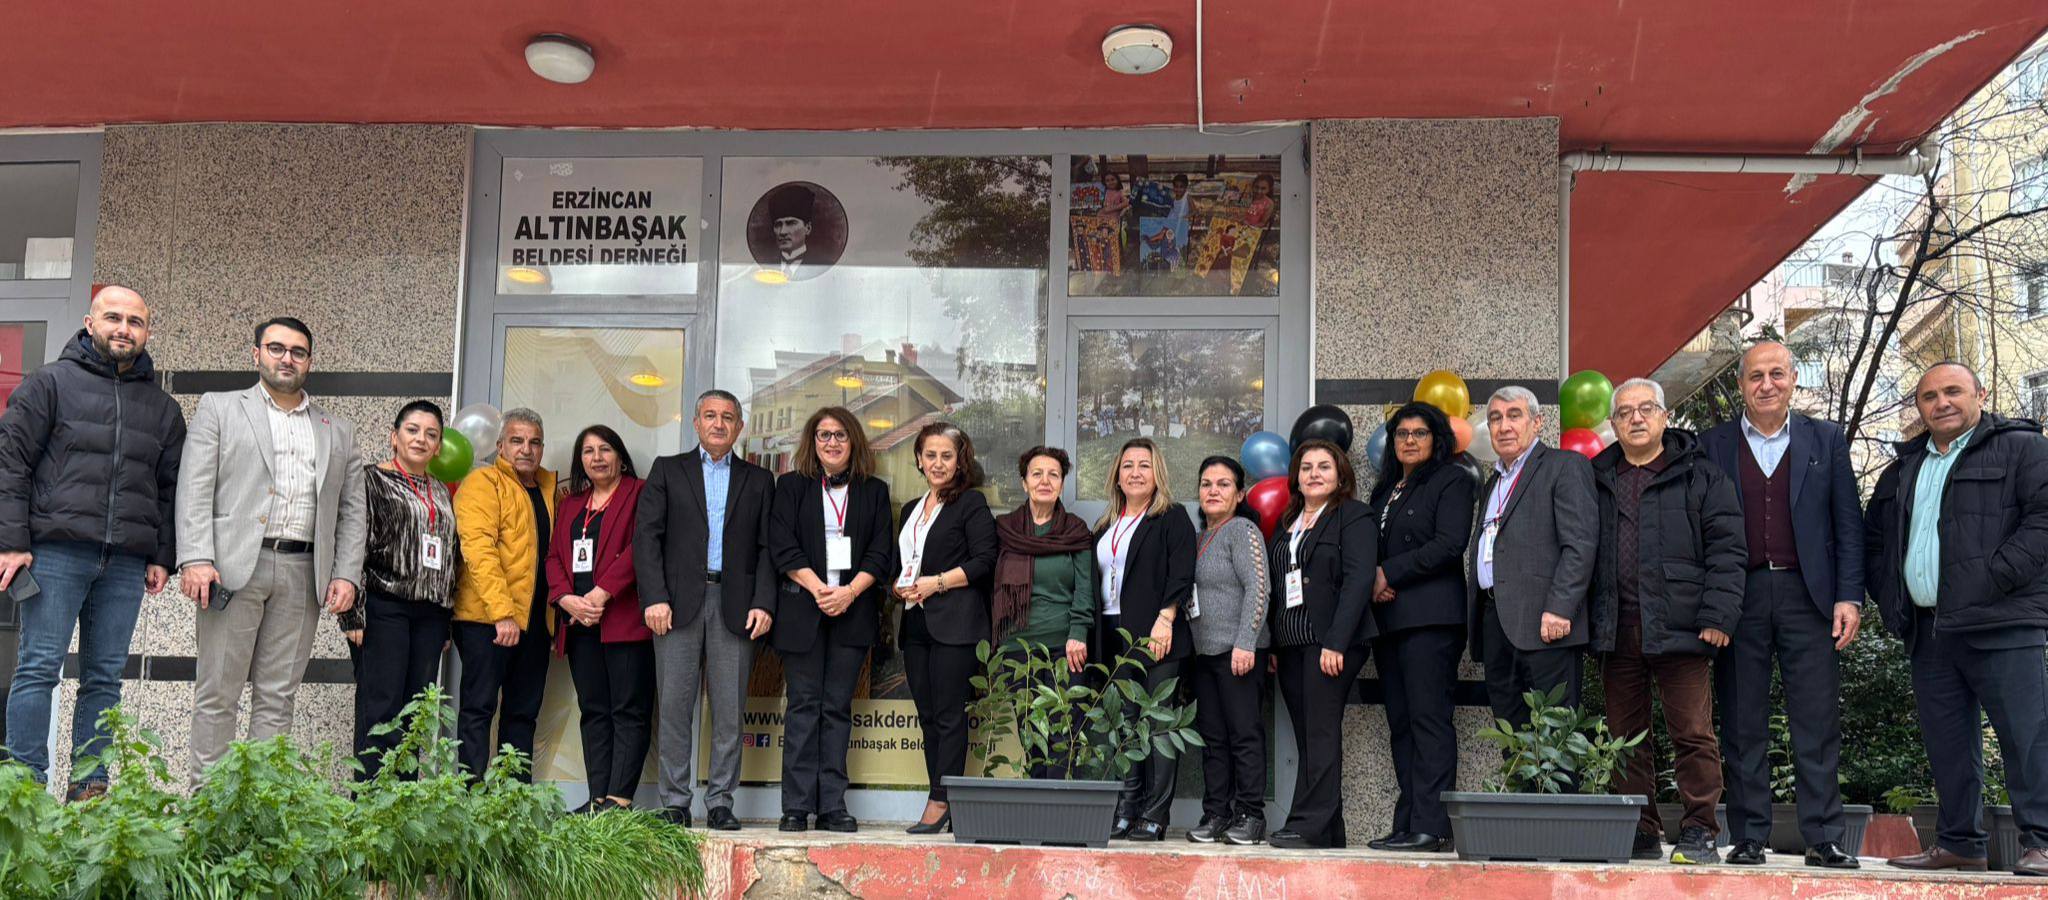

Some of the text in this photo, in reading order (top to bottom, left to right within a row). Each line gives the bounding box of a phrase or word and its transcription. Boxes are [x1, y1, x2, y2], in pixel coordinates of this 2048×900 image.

[552, 187, 652, 209] ERZİNCAN
[514, 215, 687, 246] ALTINBAŞAK
[512, 244, 687, 265] BELDESİ DERNEĞİ
[847, 737, 898, 752] ınbaşak
